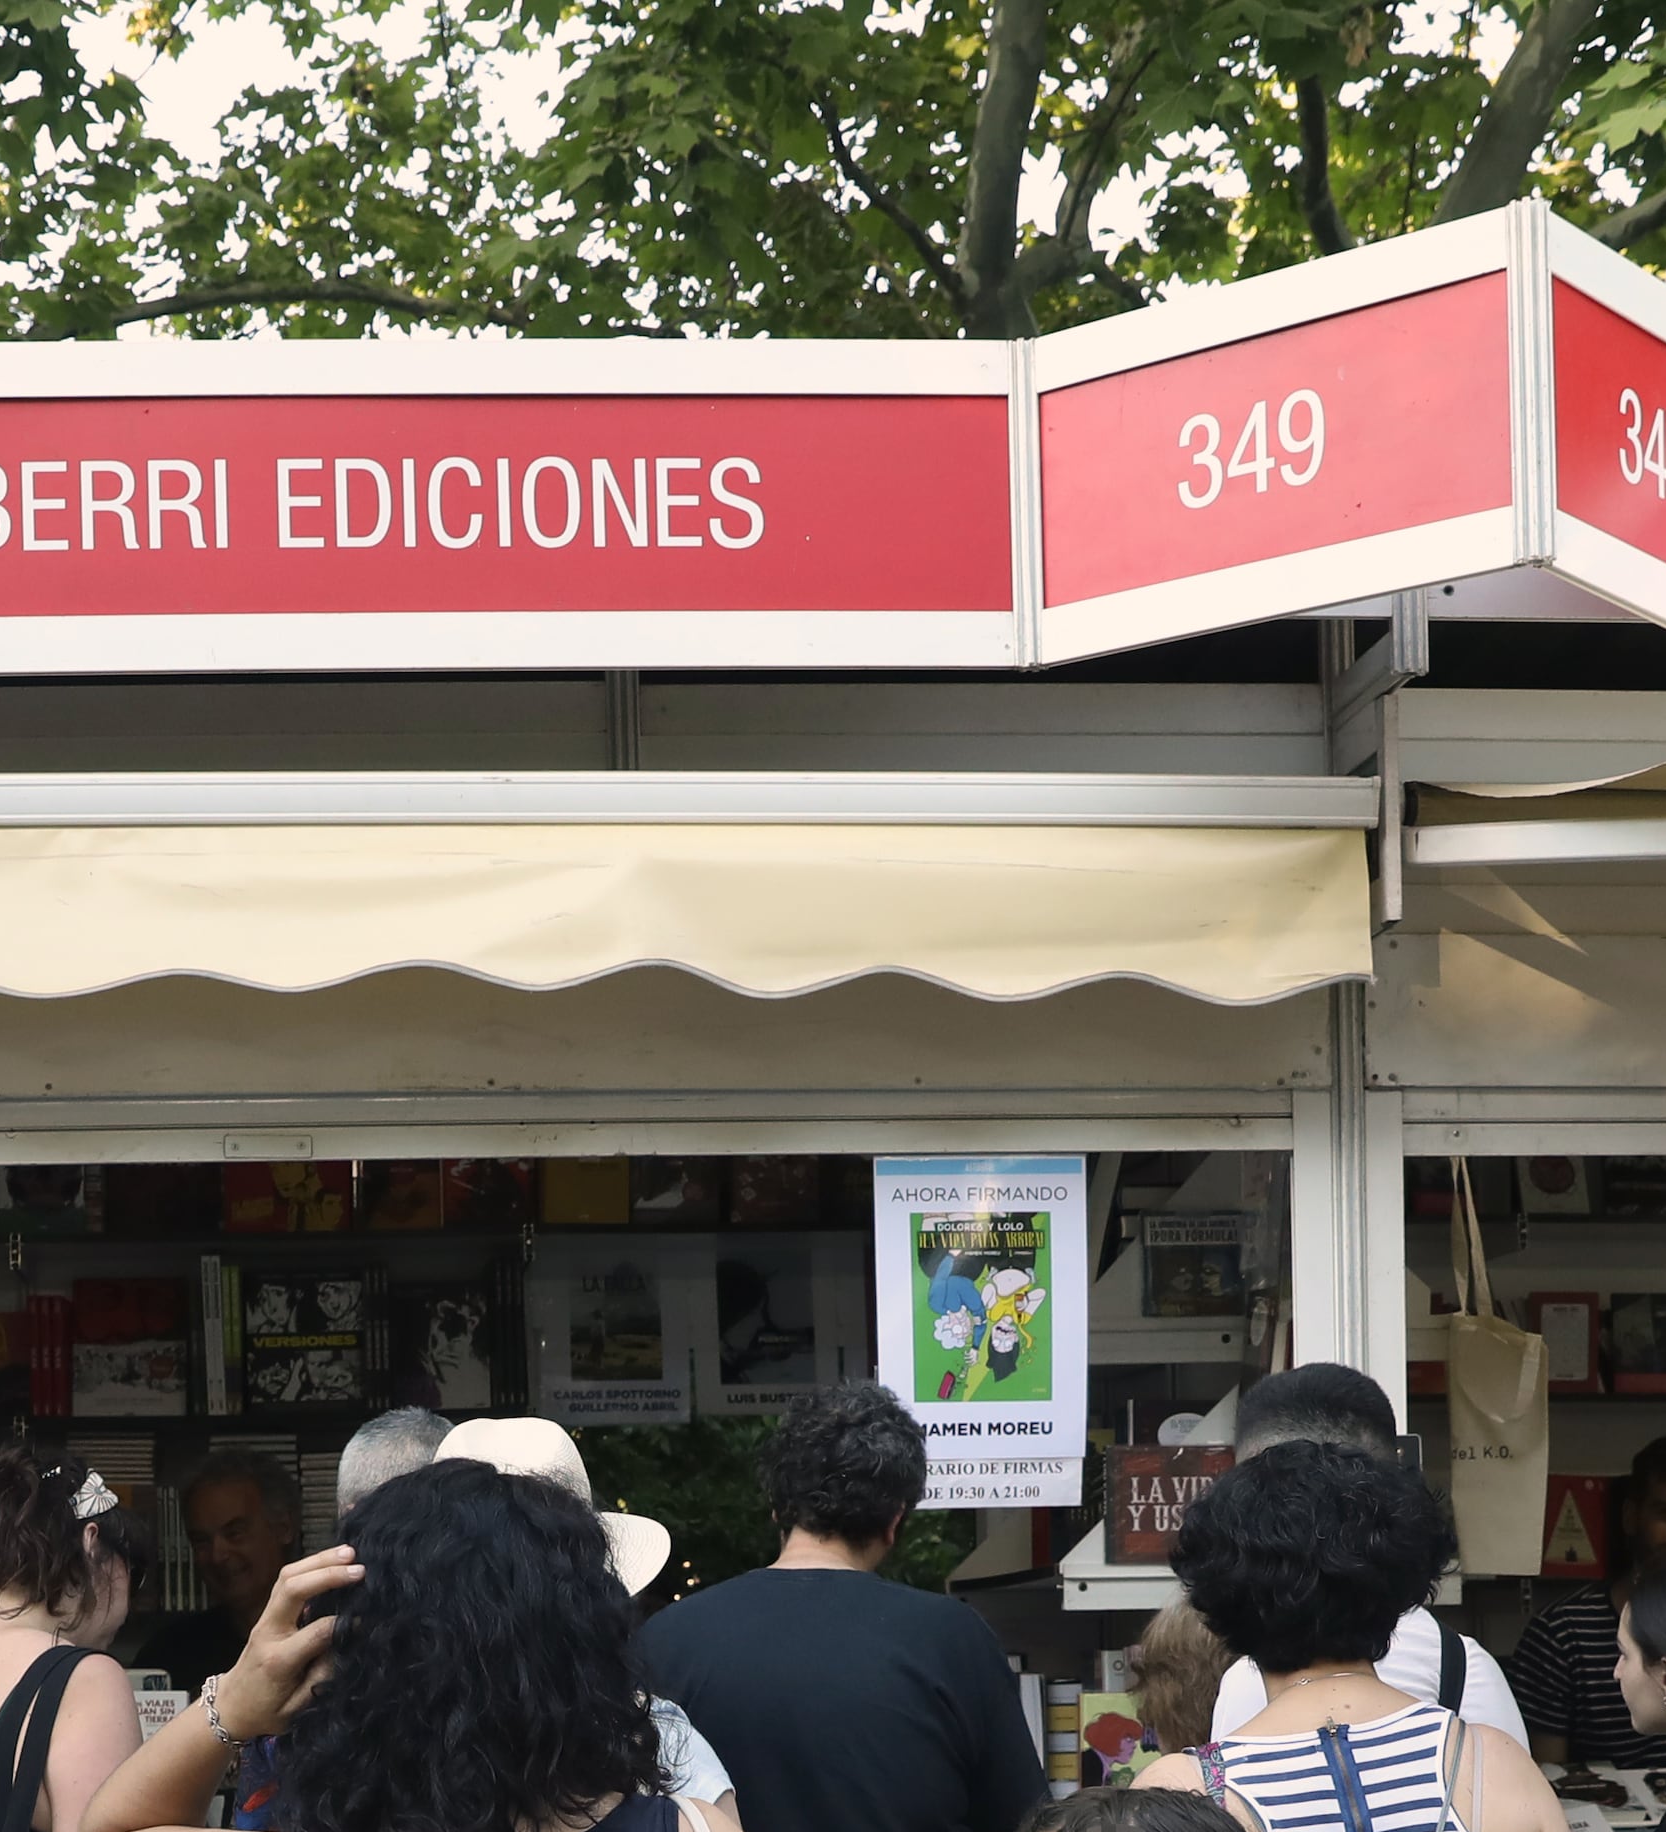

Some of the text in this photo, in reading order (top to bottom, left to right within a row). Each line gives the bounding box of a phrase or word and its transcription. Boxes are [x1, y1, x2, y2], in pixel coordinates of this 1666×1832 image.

[1174, 387, 1329, 511] 349
[277, 457, 764, 548] EDICIONES
[892, 1186, 1068, 1202] AHORA FIRMANDO
[937, 1222, 1024, 1231] DOLORES Y LOLO
[940, 1232, 966, 1248] VIDA
[970, 1232, 999, 1248] PATAS
[1006, 1231, 1044, 1248] ARRIBA!
[253, 1334, 357, 1348] VERSIONES
[554, 1388, 681, 1401] CARLOS SPOTTORNO
[727, 1393, 757, 1404] LUIS
[569, 1402, 678, 1413] GUILLERMO ABRIL
[988, 1422, 1053, 1436] MOREU
[1483, 1445, 1513, 1459] K.O.
[979, 1463, 999, 1475] DE
[1004, 1462, 1063, 1475] FIRMAS
[923, 1486, 1041, 1499] DE 19:30 A 21:00
[1131, 1477, 1165, 1503] LA
[1127, 1505, 1145, 1531] Y
